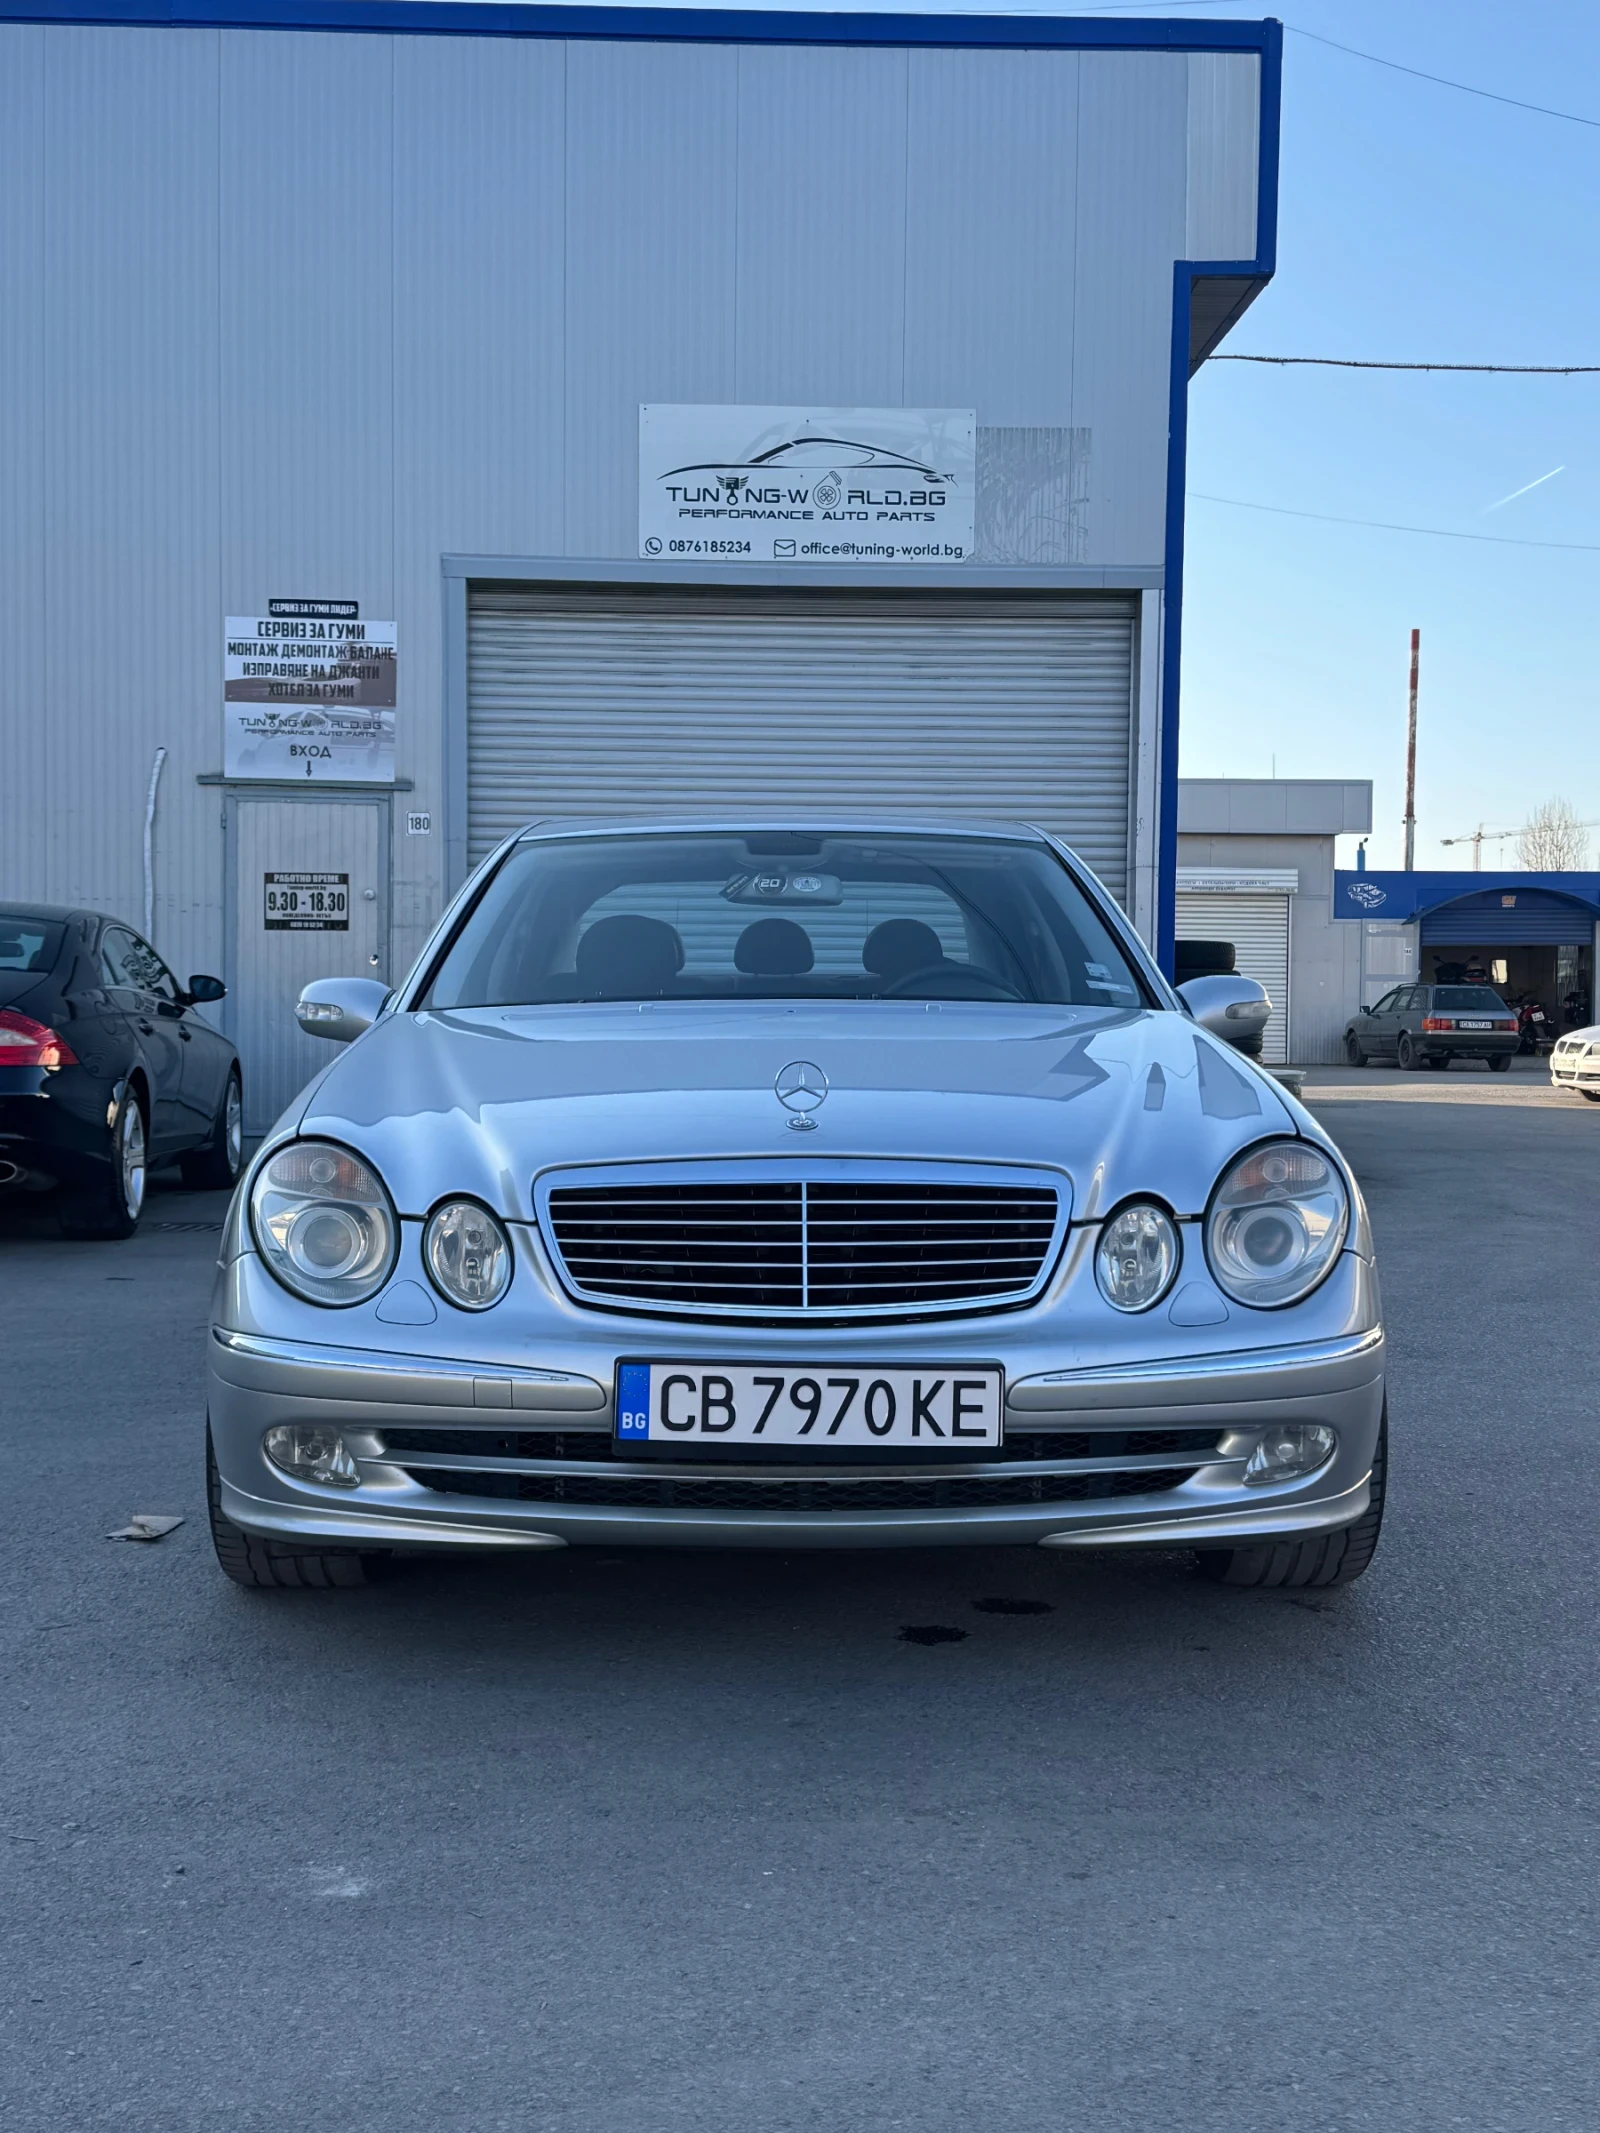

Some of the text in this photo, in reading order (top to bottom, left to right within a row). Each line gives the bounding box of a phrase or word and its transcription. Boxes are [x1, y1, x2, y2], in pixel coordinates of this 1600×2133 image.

[678, 508, 936, 522] PERFORMANCE AUTO PARTS
[669, 540, 963, 559] 0876185234 office@tuning-world.bg
[257, 621, 365, 640] СЕРВИЗ ЗА ГУМИ
[228, 642, 278, 657] МОНТАЖ
[281, 644, 346, 660] ДЕМОНТАЖ
[243, 662, 380, 680] ИЗПРАВЯНЕ НА ДЖАНТИ
[268, 683, 354, 699] ХОТЕЛ ЗА ГУМИ
[290, 745, 332, 759] ВХОД
[409, 817, 430, 831] 180
[274, 874, 340, 883] РАБОТНО ВРЕМЕ
[268, 891, 298, 911] 9.30
[308, 892, 345, 912] 18.30
[622, 1374, 987, 1438] BG CB 7970 KE
